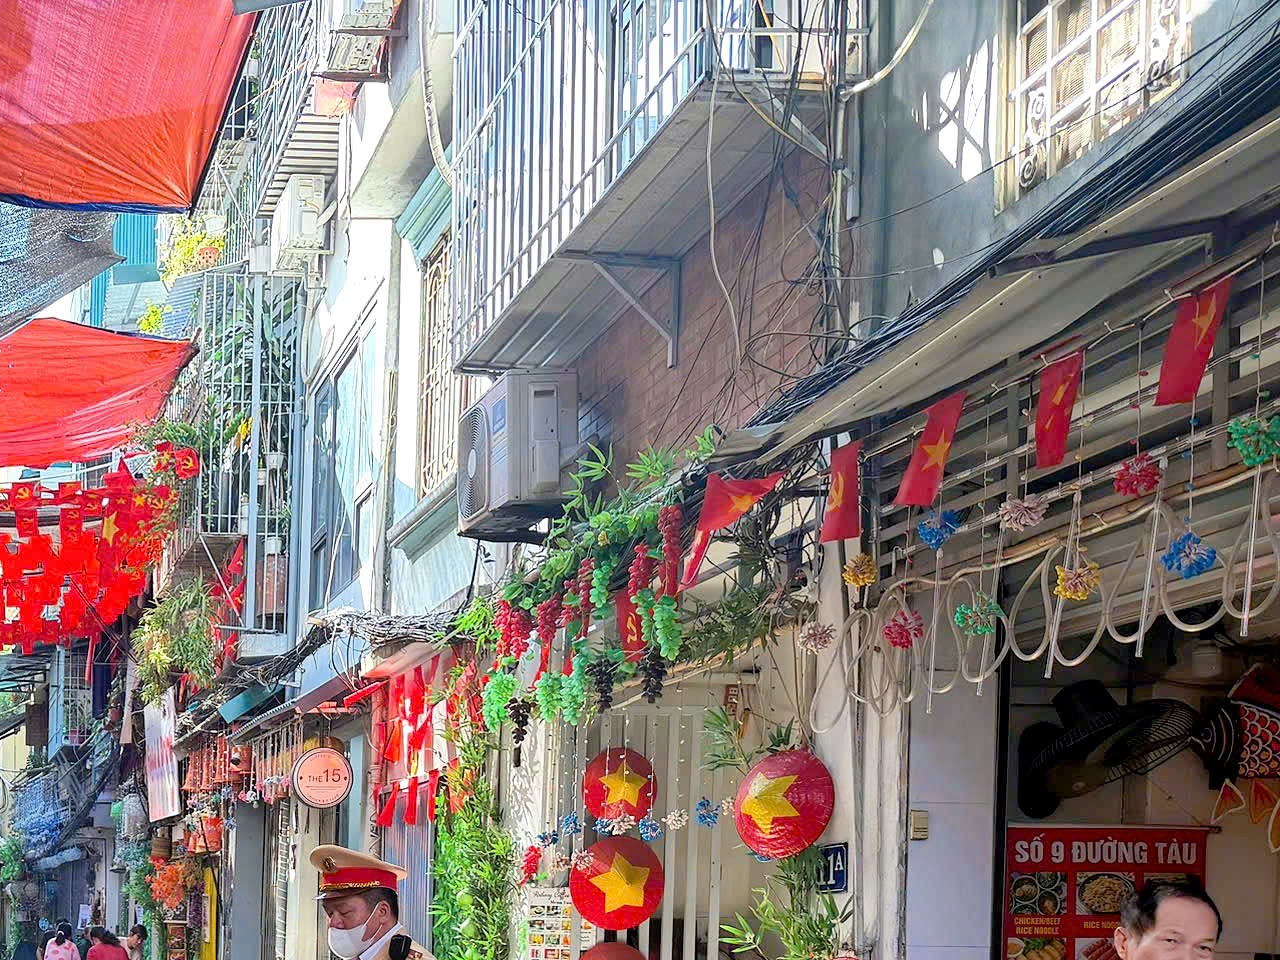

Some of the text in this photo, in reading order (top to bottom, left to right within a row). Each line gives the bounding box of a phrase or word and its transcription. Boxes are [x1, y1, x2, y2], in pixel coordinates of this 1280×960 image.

[308, 768, 342, 783] THE 15
[1015, 833, 1197, 865] SỐ 9 ĐƯỜNG TÀU
[1083, 920, 1100, 929] RICE
